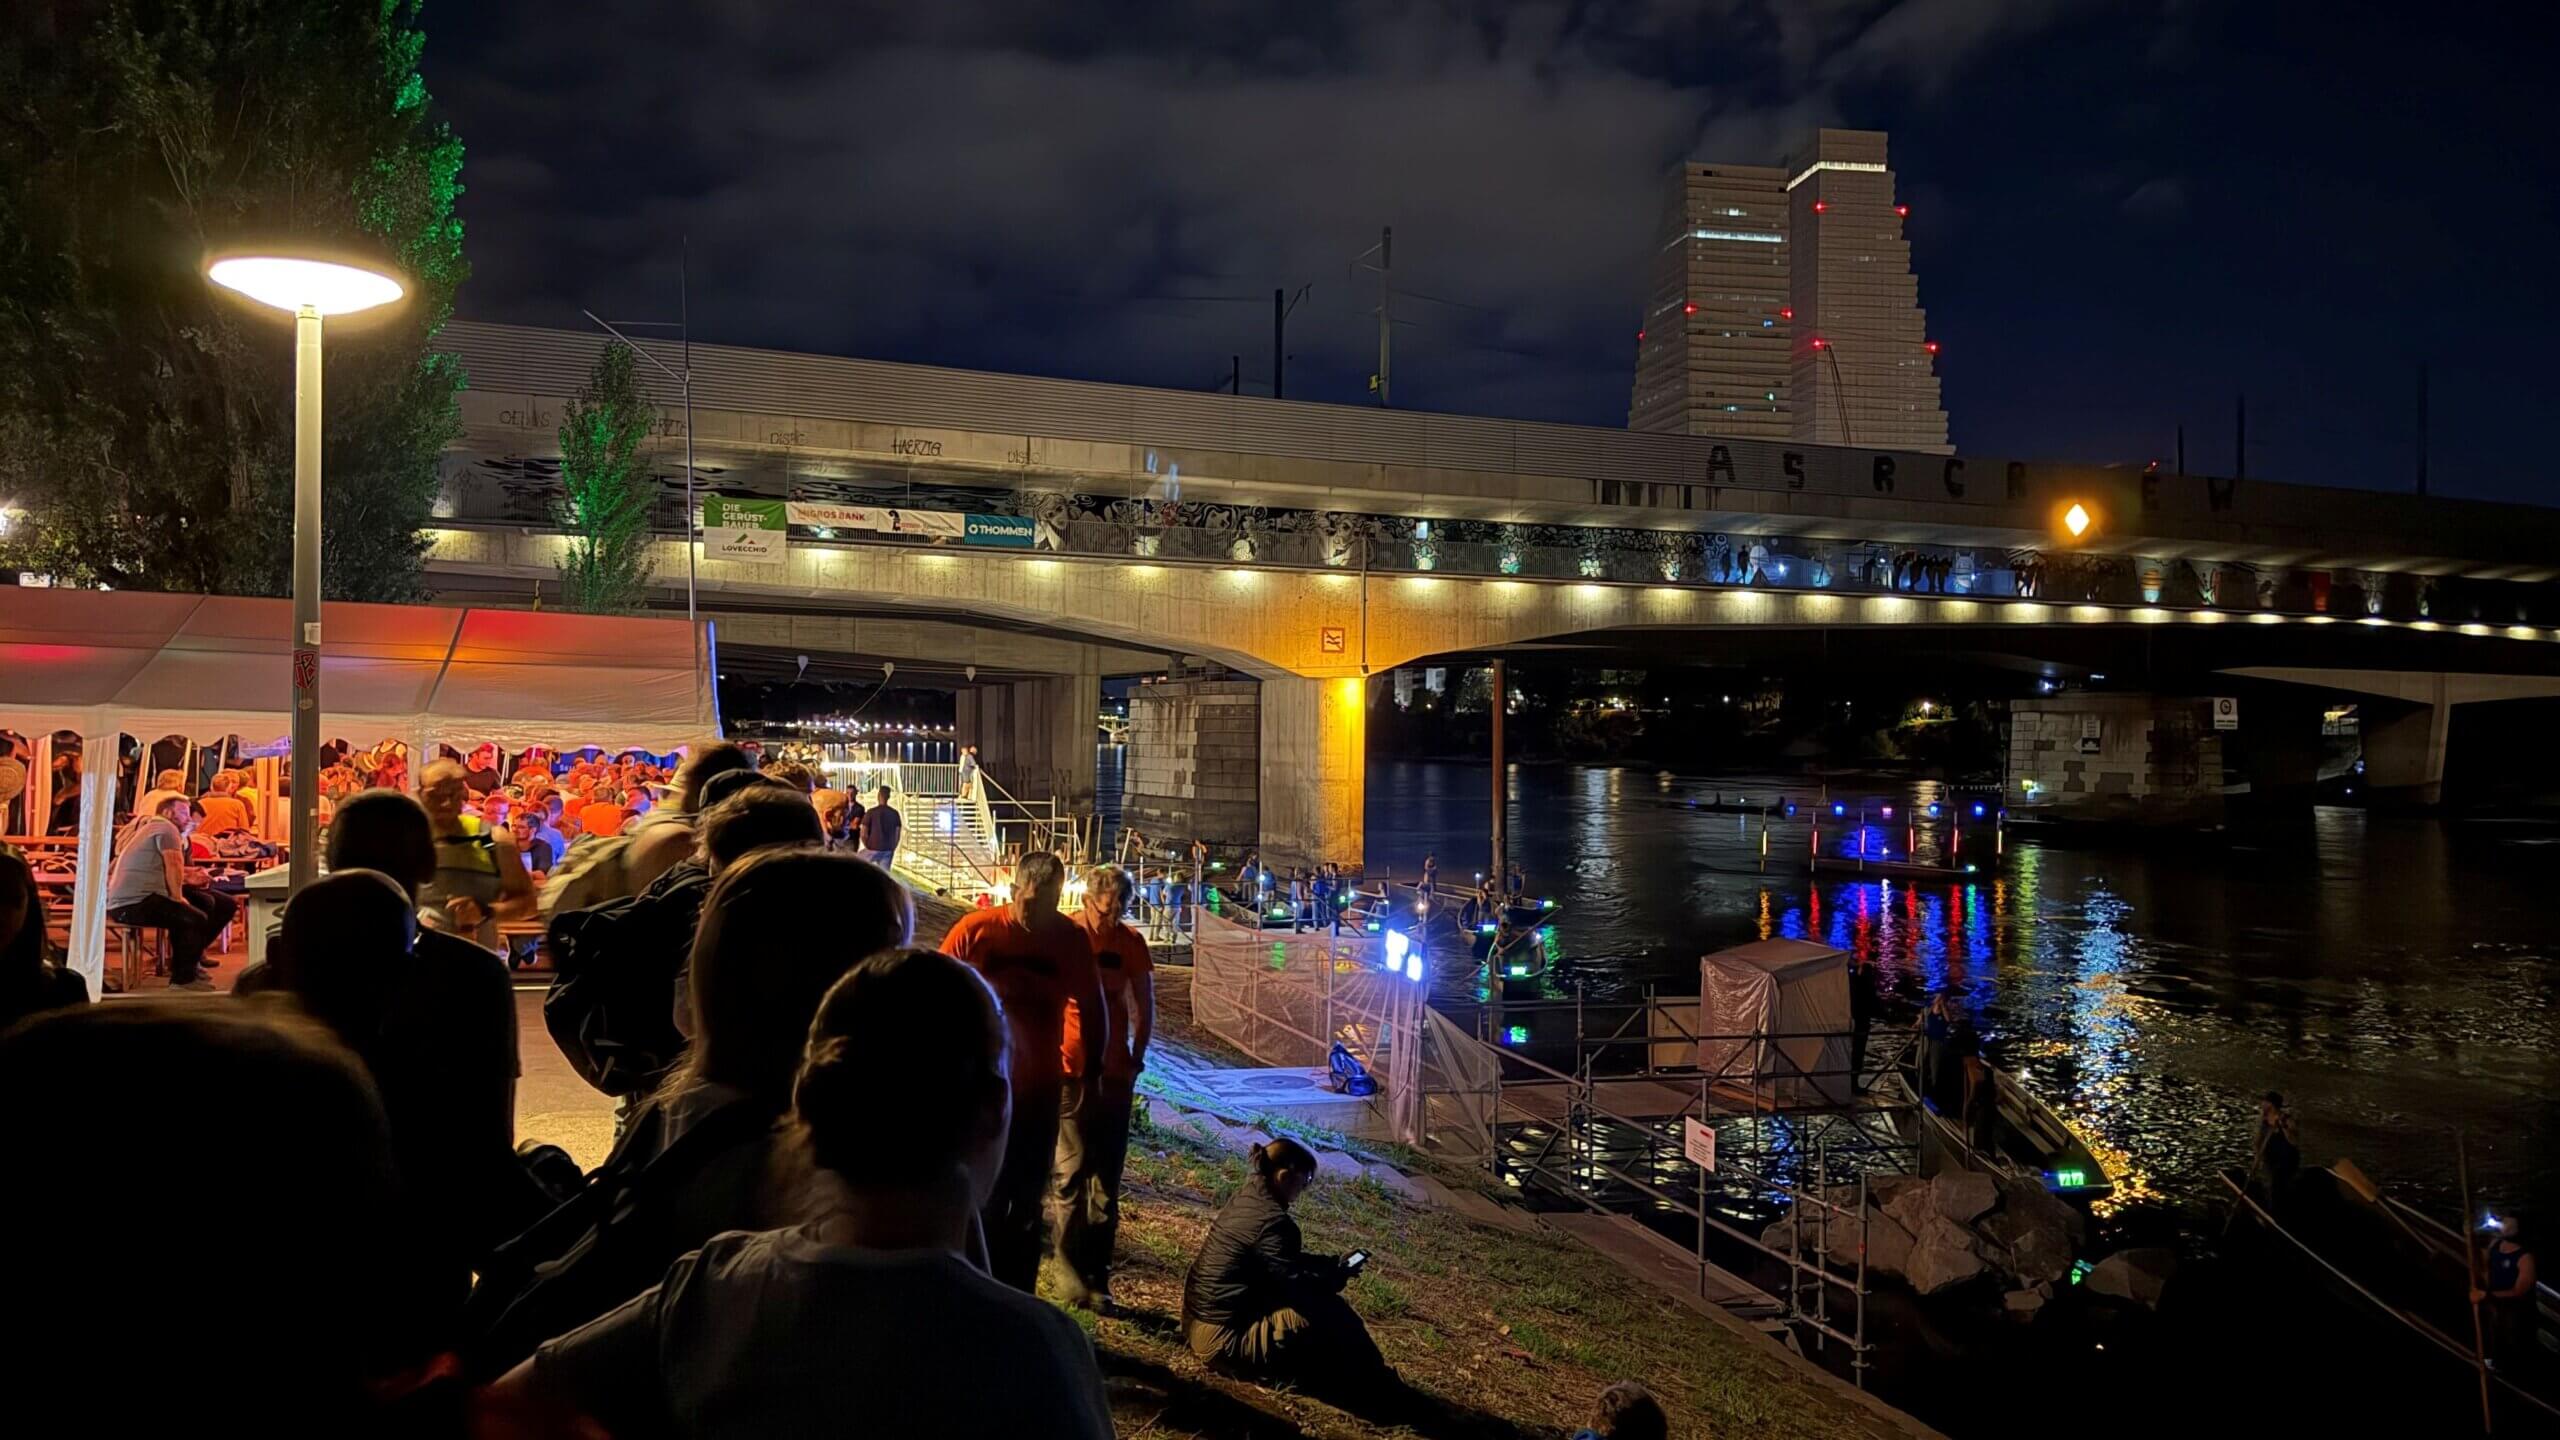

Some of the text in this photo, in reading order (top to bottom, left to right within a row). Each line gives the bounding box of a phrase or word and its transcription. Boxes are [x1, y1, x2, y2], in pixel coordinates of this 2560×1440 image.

[722, 503, 741, 512] DIE
[722, 511, 768, 522] GERÜST-
[839, 510, 866, 521] BANK
[979, 524, 1033, 537] THOMMEN
[722, 544, 767, 553] LOVECCHIO
